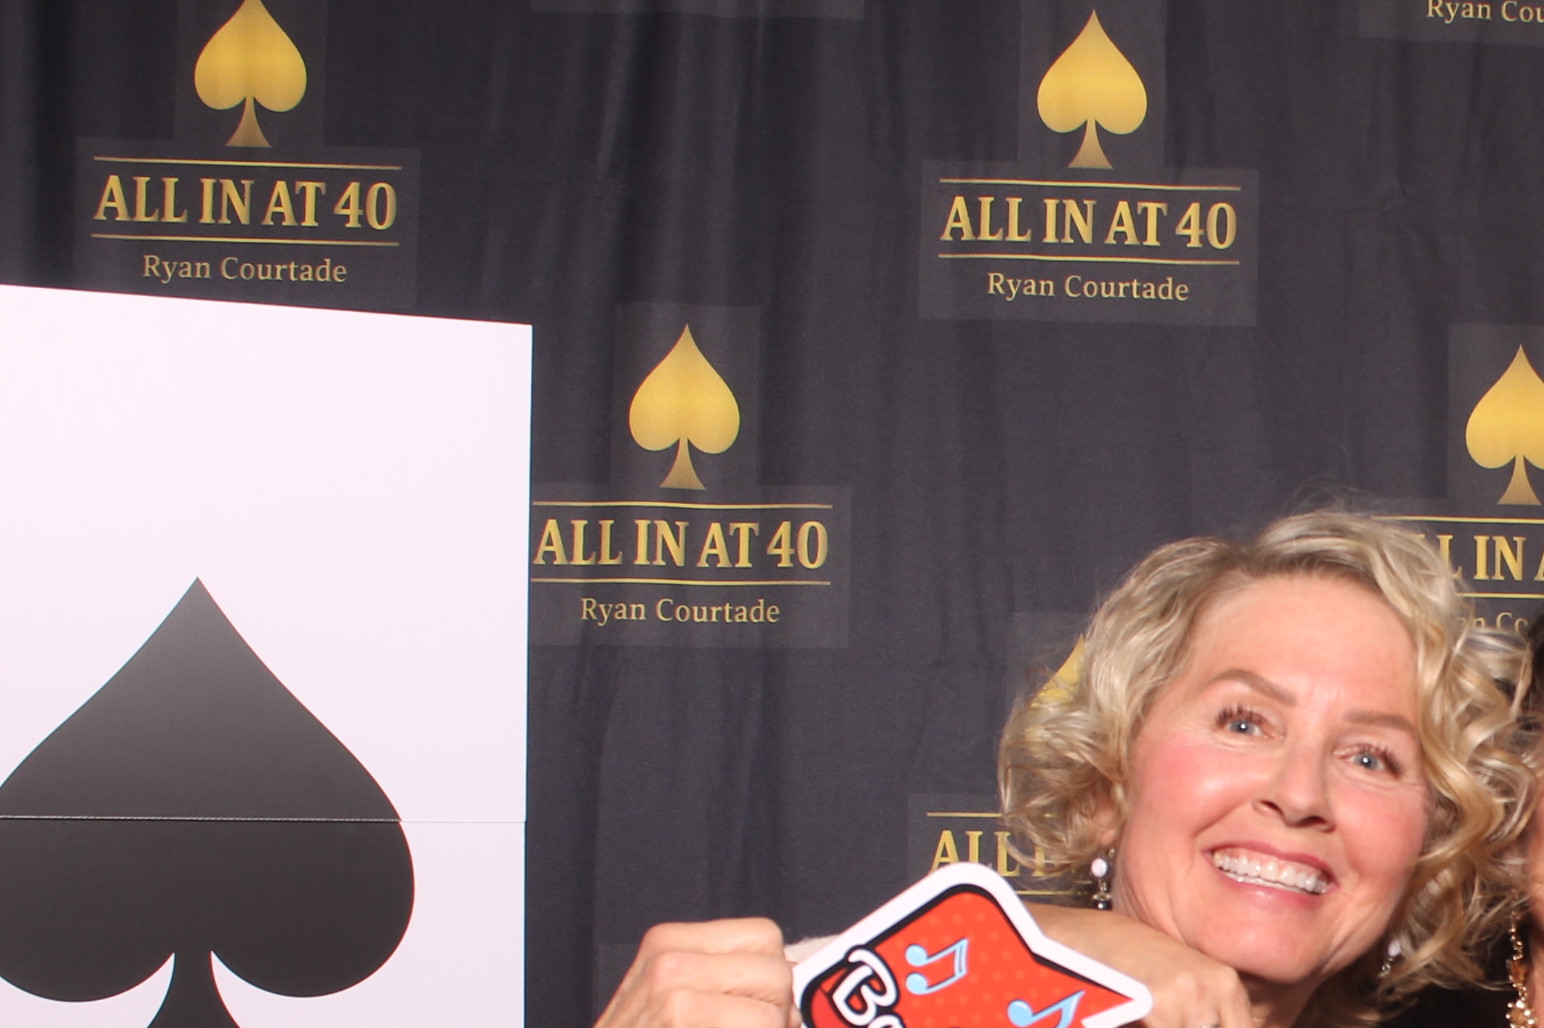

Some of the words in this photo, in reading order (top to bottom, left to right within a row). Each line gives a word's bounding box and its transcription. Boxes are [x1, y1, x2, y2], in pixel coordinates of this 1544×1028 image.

[1427, 0, 1491, 24] Ryan
[93, 174, 187, 223] ALL
[199, 178, 254, 225] IN
[262, 180, 326, 227] AT
[334, 181, 396, 230] 40
[940, 195, 1032, 242] ALL
[1042, 198, 1096, 244] IN
[1104, 200, 1167, 246] AT
[1175, 202, 1236, 250] 40
[143, 254, 211, 284] Ryan
[220, 256, 347, 283] Courtade
[988, 272, 1055, 302] Ryan
[1064, 275, 1189, 301] Courtade
[532, 518, 622, 566] ALL
[633, 519, 688, 567] IN
[696, 522, 759, 568] AT
[767, 520, 828, 569] 40
[1473, 535, 1525, 581] IN
[581, 597, 646, 627] Ryan
[655, 598, 780, 623] Courtade
